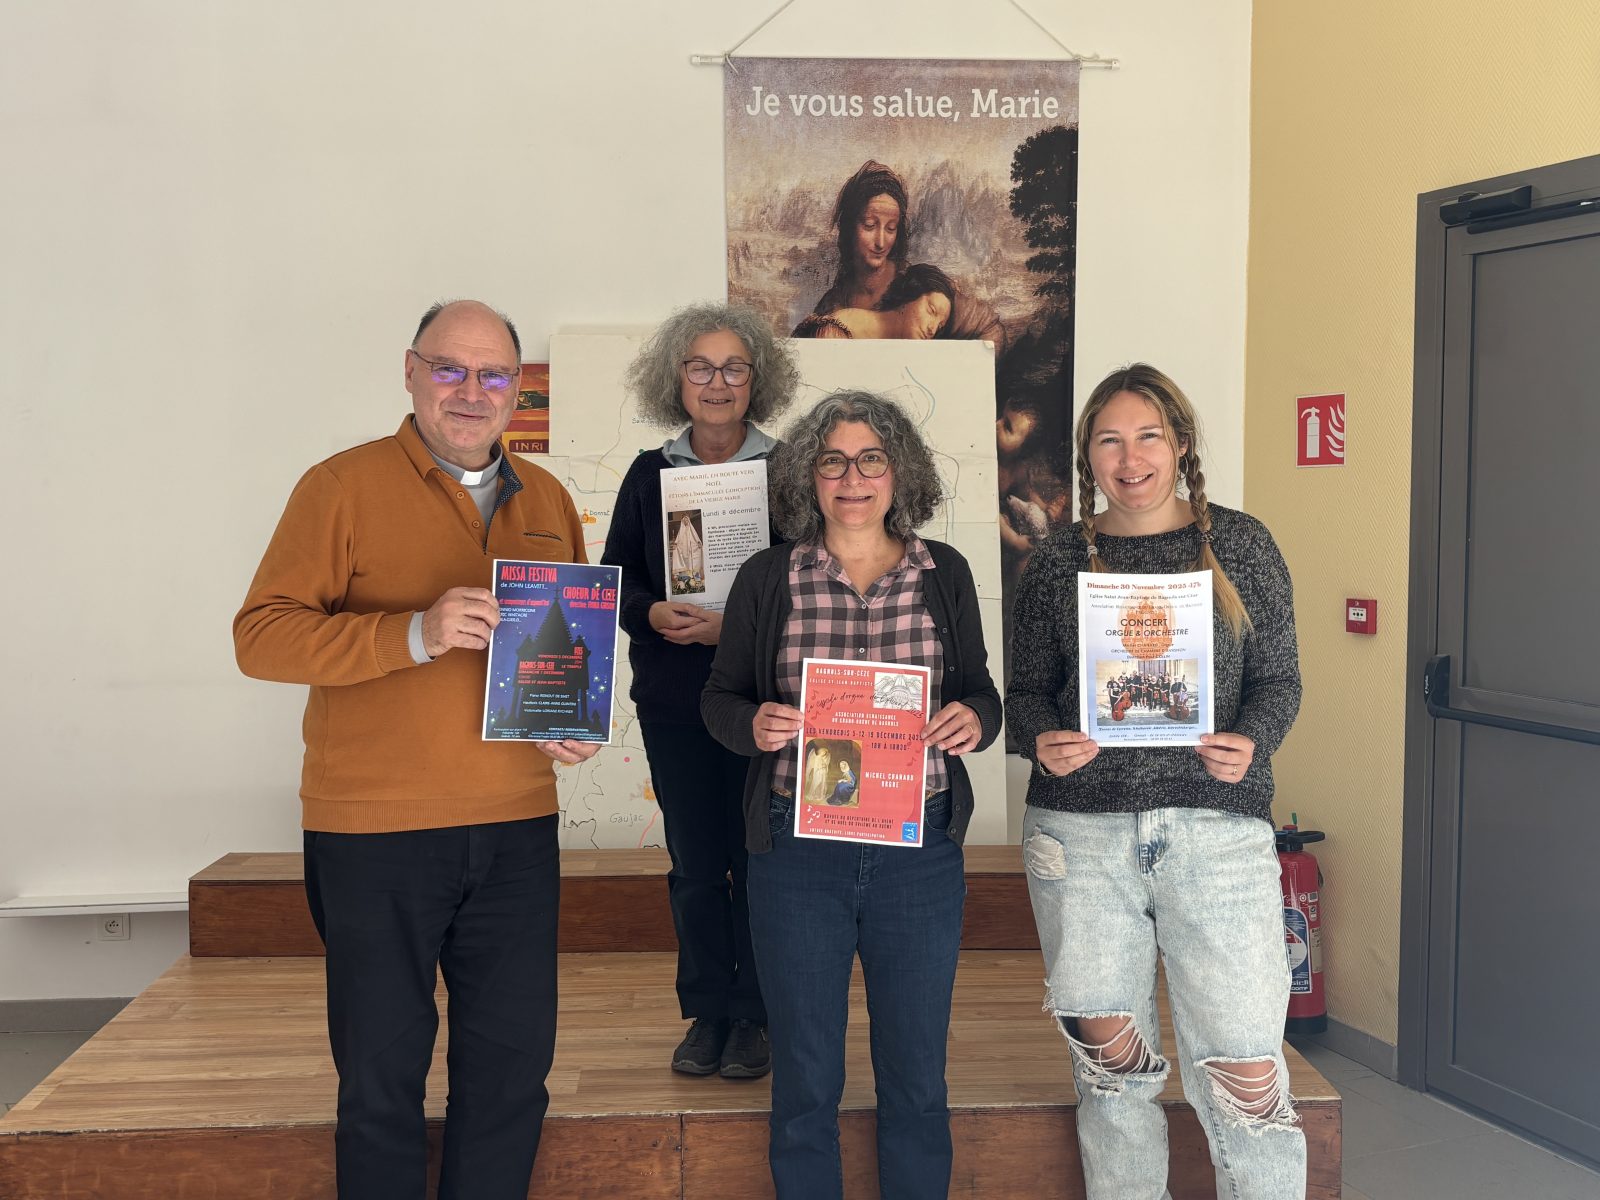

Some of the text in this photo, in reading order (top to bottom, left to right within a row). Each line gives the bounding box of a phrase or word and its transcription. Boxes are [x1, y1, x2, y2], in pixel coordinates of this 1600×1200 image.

[746, 86, 1058, 122] Je vous salue, Marie
[515, 442, 544, 452] INRI
[729, 507, 762, 515] décembre
[501, 566, 557, 583] MISSA FESTIVA
[1087, 582, 1119, 590] Dimanche
[591, 588, 600, 601] DE
[1120, 618, 1168, 628] CONCERT
[1105, 629, 1134, 638] ORGUE
[1143, 628, 1189, 638] ORCHESTRE
[835, 711, 865, 719] ASSOCIATION
[818, 728, 850, 737] VENDREDIS
[865, 771, 887, 780] MICHEL
[881, 780, 900, 789] ORGUE
[609, 812, 644, 827] Gaujac
